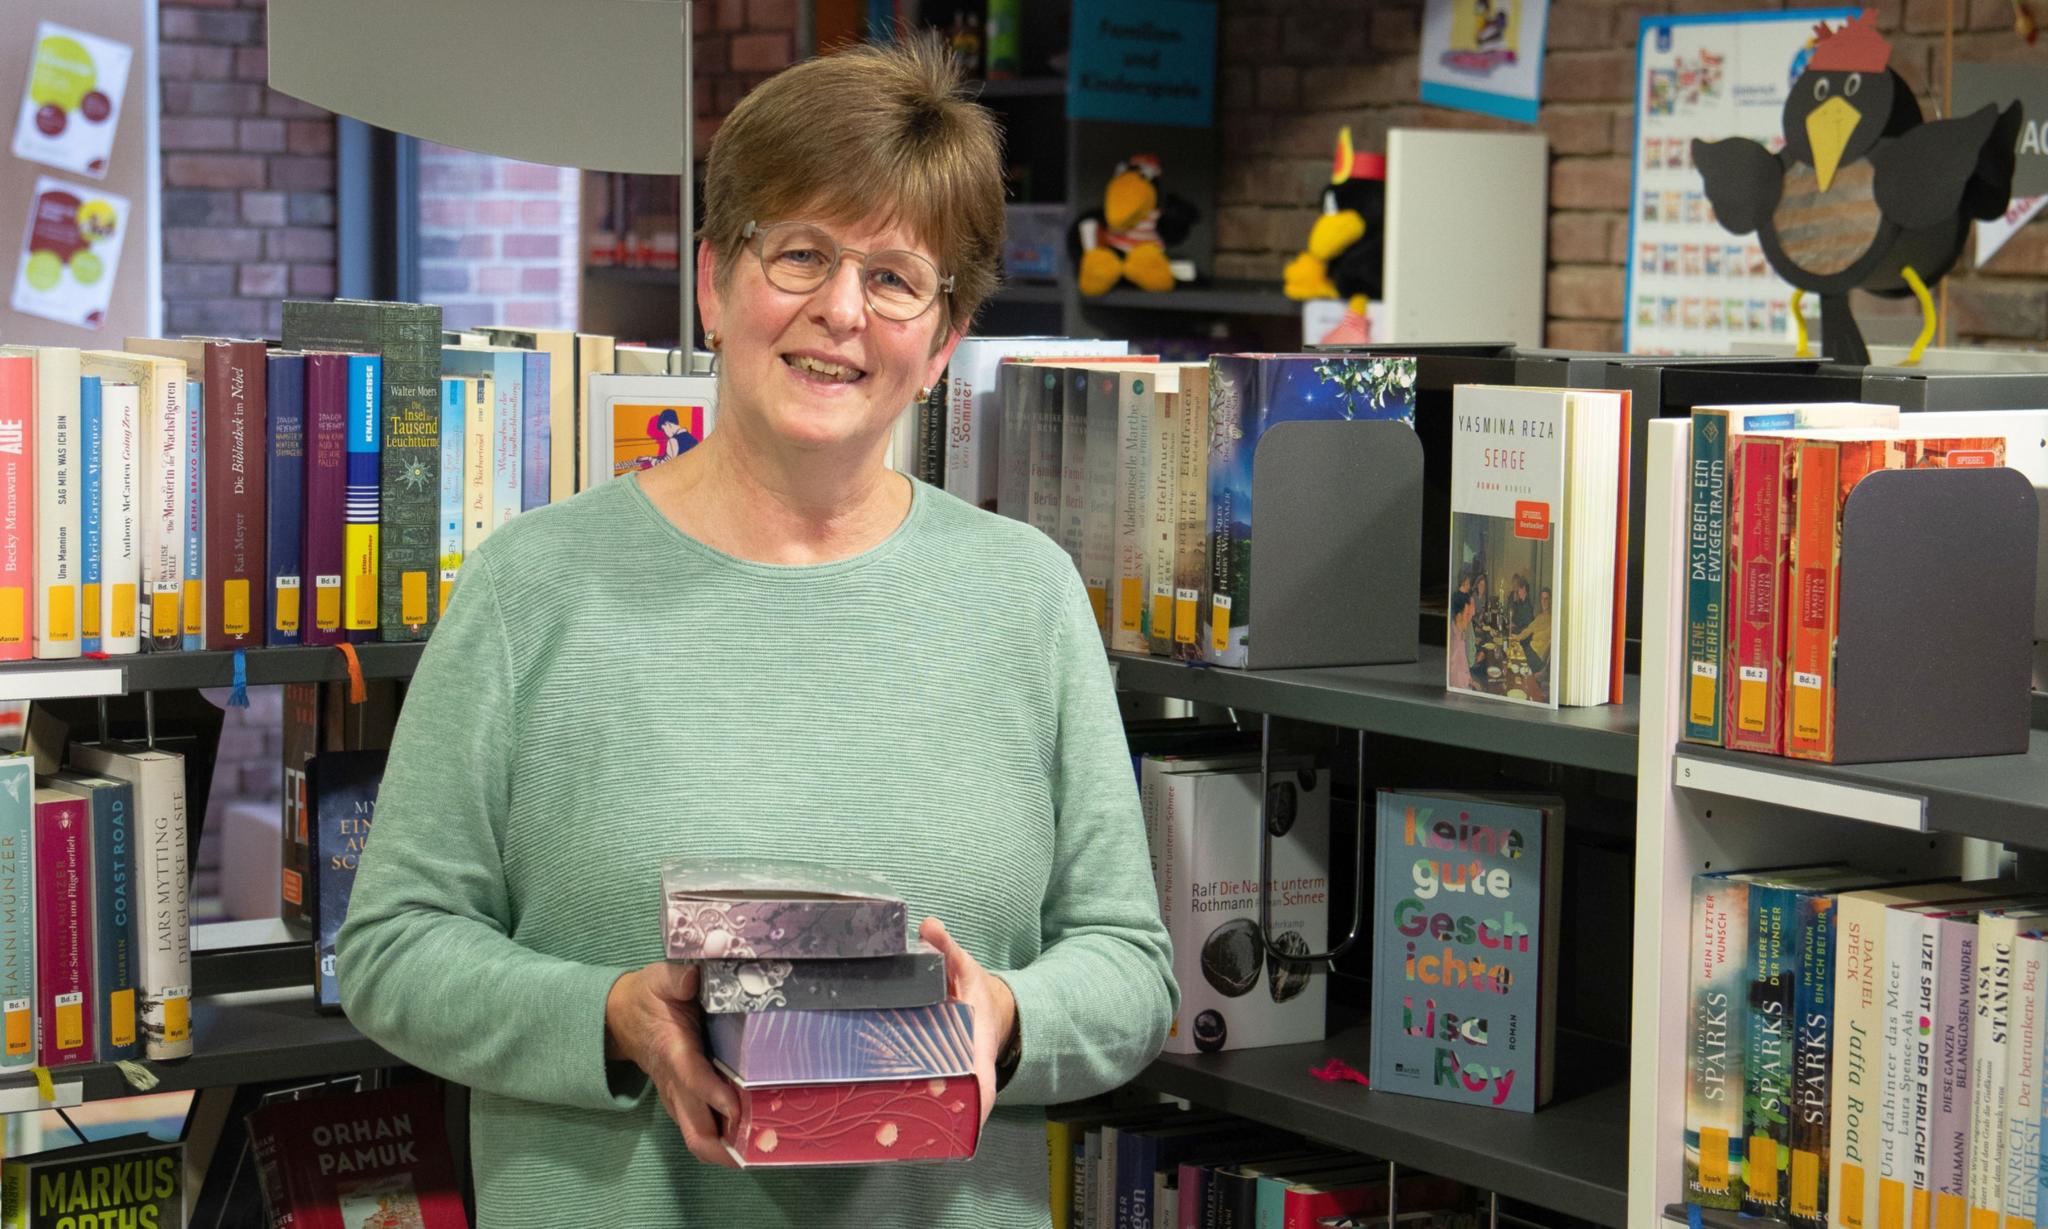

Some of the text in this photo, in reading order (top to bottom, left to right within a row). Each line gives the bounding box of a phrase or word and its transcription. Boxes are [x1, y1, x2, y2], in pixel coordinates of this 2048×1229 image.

[365, 365, 374, 442] KNALLKREBSE
[391, 385, 437, 397] Walter Moers
[405, 408, 426, 420] Insel
[951, 377, 961, 448] träumten
[959, 381, 972, 442] Sommer
[1214, 389, 1225, 452] ATLAS
[57, 415, 68, 505] SAG MIR, WAS ICH BIN
[161, 382, 181, 518] Meisterin Wachsfiguren
[231, 367, 244, 494] Die Bibliothek im Nebel
[391, 417, 438, 435] Tausend
[1180, 387, 1192, 476] Eifelfrauen
[1458, 415, 1554, 439] YASMINA REZA
[1484, 448, 1526, 470] SERGE
[121, 406, 132, 560] Anthony McCarten Going Zero
[1124, 405, 1140, 536] Mademoiselle Marthe
[1156, 431, 1169, 523] Eifelfrauen
[1764, 474, 1773, 505] Rausch
[5, 463, 19, 571] Becky Manawatu
[234, 512, 245, 572] Kai Meyer
[1180, 490, 1188, 554] BRIGITTE
[1189, 491, 1197, 529] RIEBE
[1220, 491, 1231, 590] HARRY WHITTAKER
[1693, 459, 1708, 581] DAS LEBEN EIN
[1709, 460, 1723, 582] EWIGER TRAUM
[57, 527, 67, 579] Una Mannion
[88, 529, 100, 579] Gabriel
[1214, 535, 1222, 577] LUCINDA
[1756, 573, 1765, 613] MAGDA
[1810, 577, 1819, 619] MAGDA
[1800, 676, 1811, 684] Bd.
[1685, 767, 1691, 778] S
[112, 800, 128, 926] COAST ROAD
[1165, 785, 1175, 912] Die Nacht unterm Schnee
[1403, 805, 1525, 861] Keine
[19, 828, 30, 935] ein Sehnsuchtsort
[66, 835, 80, 983] die Sehnsucht uns Flügel verlieh
[155, 816, 172, 951] LARS MYTTING
[1192, 877, 1325, 898] Ralf Die unterm
[1192, 892, 1325, 913] Rothmann Schnee
[1412, 859, 1513, 900] gute
[1393, 897, 1529, 953] Gesch
[1704, 895, 1715, 978] MEIN LETZTER
[1716, 912, 1727, 964] WUNSCH
[1757, 906, 1768, 983] UNSERE ZEIT
[1769, 907, 1782, 986] DER WUNDER
[1803, 926, 1814, 986] IM TRAUM
[1814, 912, 1827, 1004] BIN ICH BEI DIR
[1847, 923, 1860, 981] SPECK
[2, 929, 19, 996] HANNI
[117, 939, 127, 986] MURRIN
[1405, 941, 1514, 996] ichte
[1861, 940, 1874, 1009] DANIEL
[1919, 934, 1933, 1013] LIZE SPIT
[1403, 996, 1488, 1048] Lisa
[1509, 1014, 1517, 1050] ROMAN
[1696, 1004, 1706, 1082] NICHOLAS
[1705, 991, 1728, 1101] SPARKS
[1956, 940, 1972, 1088] BELANGLOSEN WUNDER
[2017, 960, 2038, 1107] Der betrunkene Berg
[1434, 1047, 1515, 1106] Roy
[1752, 1014, 1761, 1094] NICHOLAS
[1760, 1000, 1783, 1113] SPARKS
[1796, 1026, 1806, 1106] NICHOLAS
[1803, 1013, 1827, 1125] SPARKS
[1881, 960, 1900, 1178] Und dahinter das Meer
[1899, 1009, 1914, 1136] Laura Spence-Ash
[1917, 1042, 1929, 1077] DER
[1943, 1025, 1955, 1113] DIESE GANZEN
[1846, 1020, 1866, 1162] Jaffa Road
[1914, 1083, 1927, 1165] EHRLICHE
[312, 1114, 414, 1147] ORHAN
[318, 1142, 418, 1176] PAMUK
[40, 1156, 175, 1218] MARKUS
